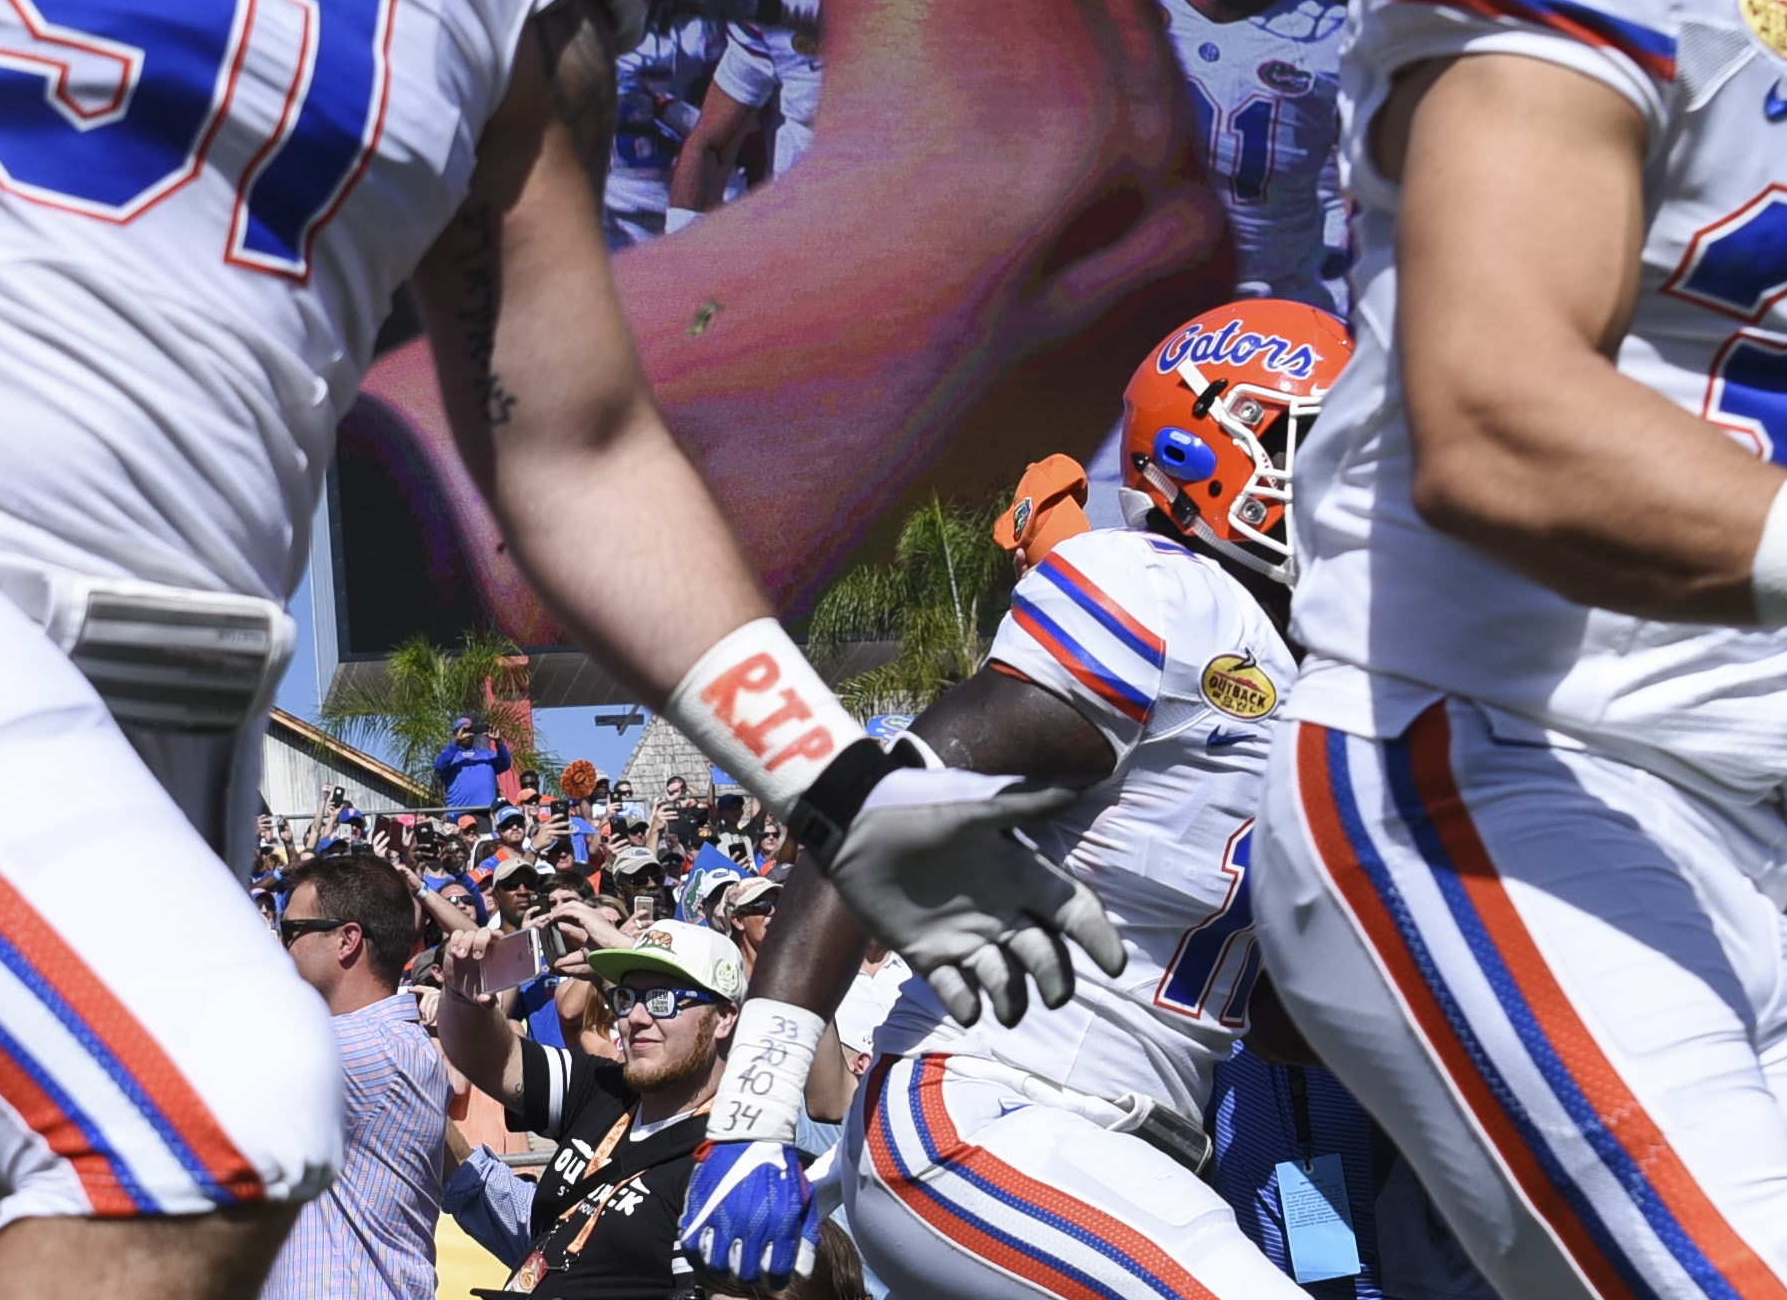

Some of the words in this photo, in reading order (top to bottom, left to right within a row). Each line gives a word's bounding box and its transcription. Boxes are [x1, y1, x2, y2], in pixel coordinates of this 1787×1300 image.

[1157, 319, 1314, 379] Gators
[1208, 674, 1267, 709] OUTBACK
[700, 652, 835, 773] RIP
[767, 1015, 798, 1039] 33
[737, 1064, 775, 1096] 40
[723, 1100, 763, 1132] 34
